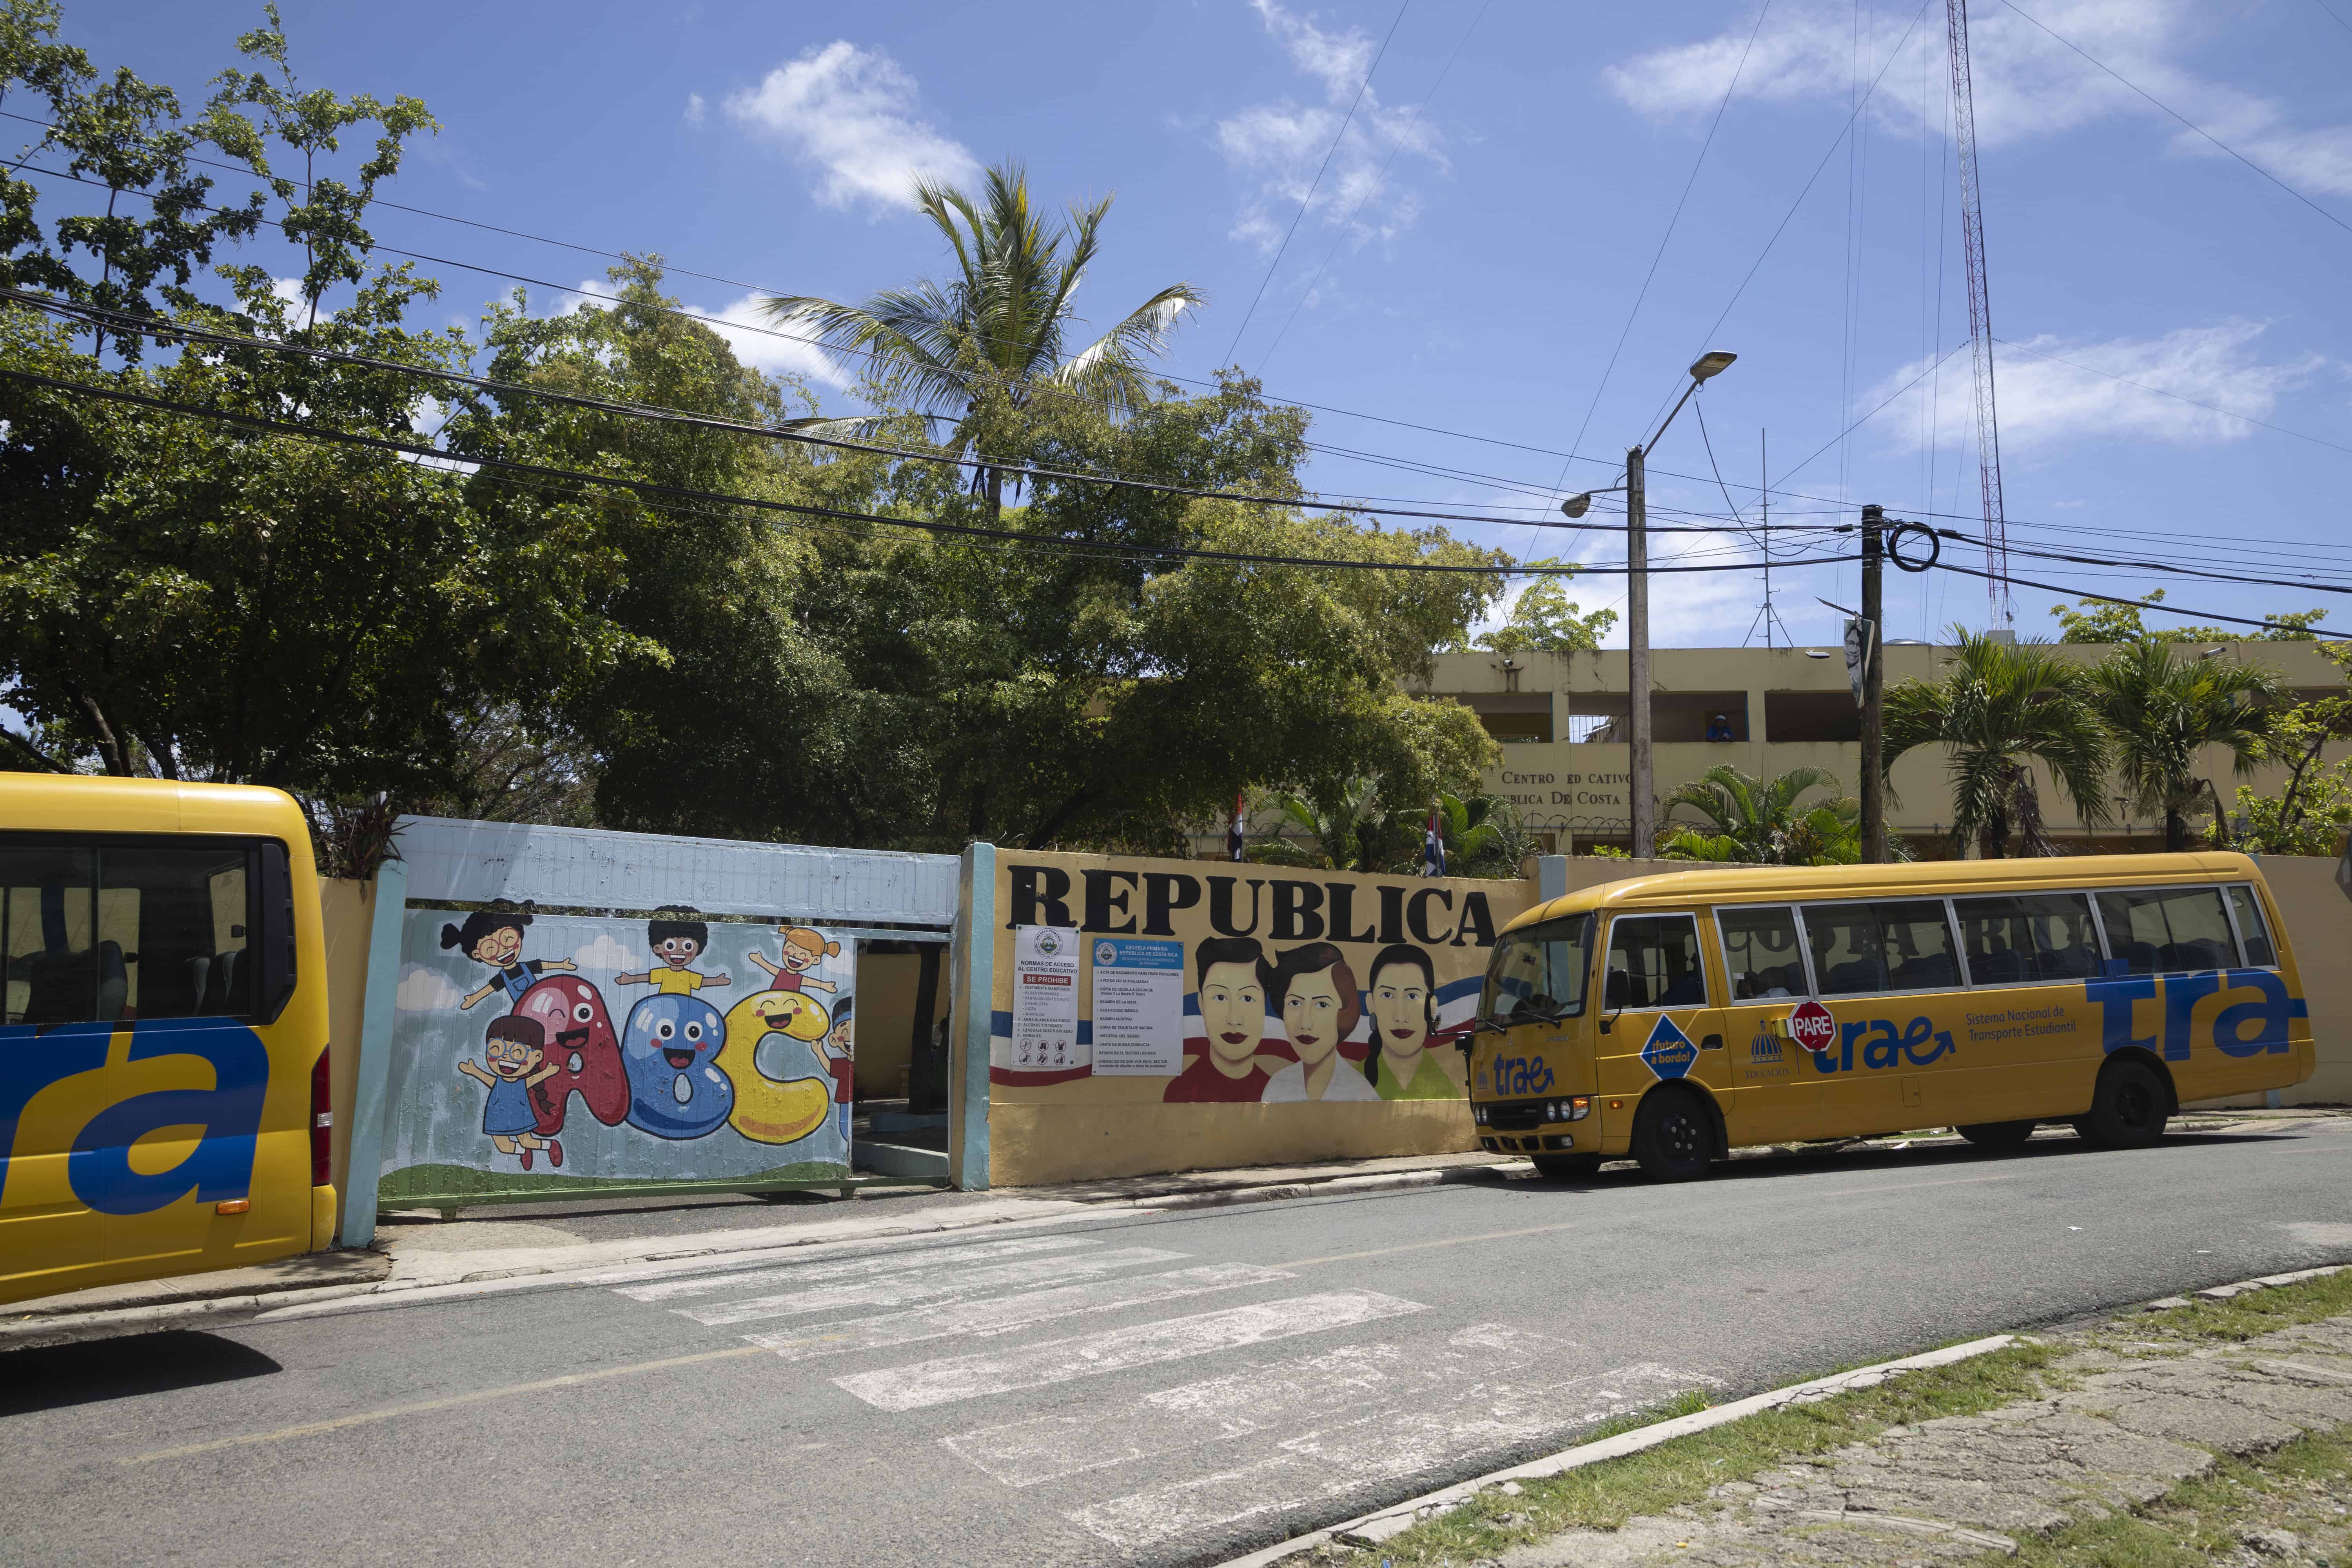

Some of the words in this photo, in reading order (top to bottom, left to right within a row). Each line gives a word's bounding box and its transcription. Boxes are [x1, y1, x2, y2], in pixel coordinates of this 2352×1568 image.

[1502, 771, 1555, 784] CENTRO
[1503, 794, 1544, 804] UBLICA
[1551, 791, 1571, 804] DE
[1577, 791, 1620, 804] COSTA
[1006, 865, 1495, 947] REPUBLICA
[1966, 1013, 2005, 1025] Sistema
[2007, 1005, 2051, 1021] Nacional
[2053, 1005, 2064, 1016] de
[1795, 1016, 1832, 1036] PARE
[1969, 1027, 2022, 1042] Transporte
[2025, 1019, 2076, 1036] Estudiantil
[1652, 1040, 1686, 1054] ¡futuro
[1651, 1056, 1657, 1065] a
[1659, 1051, 1690, 1064] bordo!
[1494, 1053, 1555, 1096] trae
